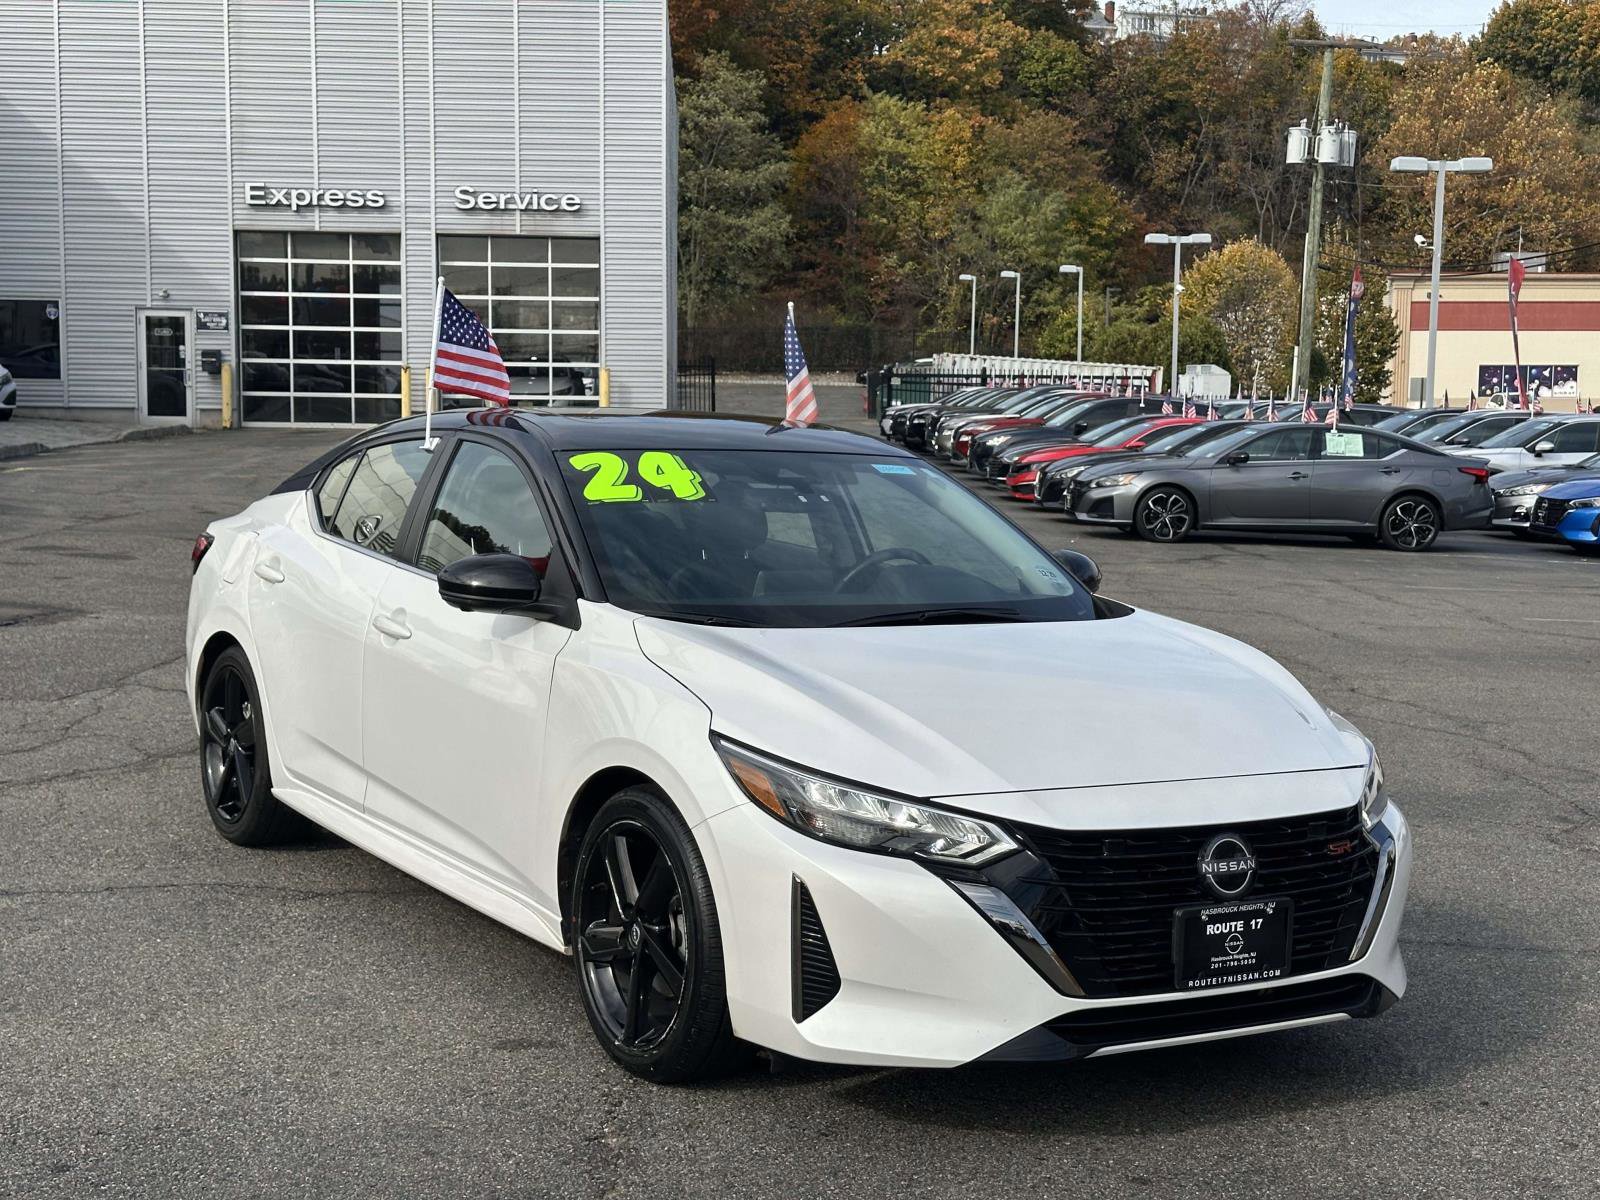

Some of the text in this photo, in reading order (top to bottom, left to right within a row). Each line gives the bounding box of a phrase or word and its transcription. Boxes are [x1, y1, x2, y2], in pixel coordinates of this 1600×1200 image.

[245, 183, 581, 211] Express Service
[569, 451, 706, 502] 24
[1202, 859, 1255, 873] NISSAN
[1201, 905, 1238, 916] HASBROUCK
[1206, 919, 1263, 935] ROUTE 17
[1224, 940, 1244, 948] NISSAN
[1188, 969, 1281, 987] ROUTE17NISSAN.COM
